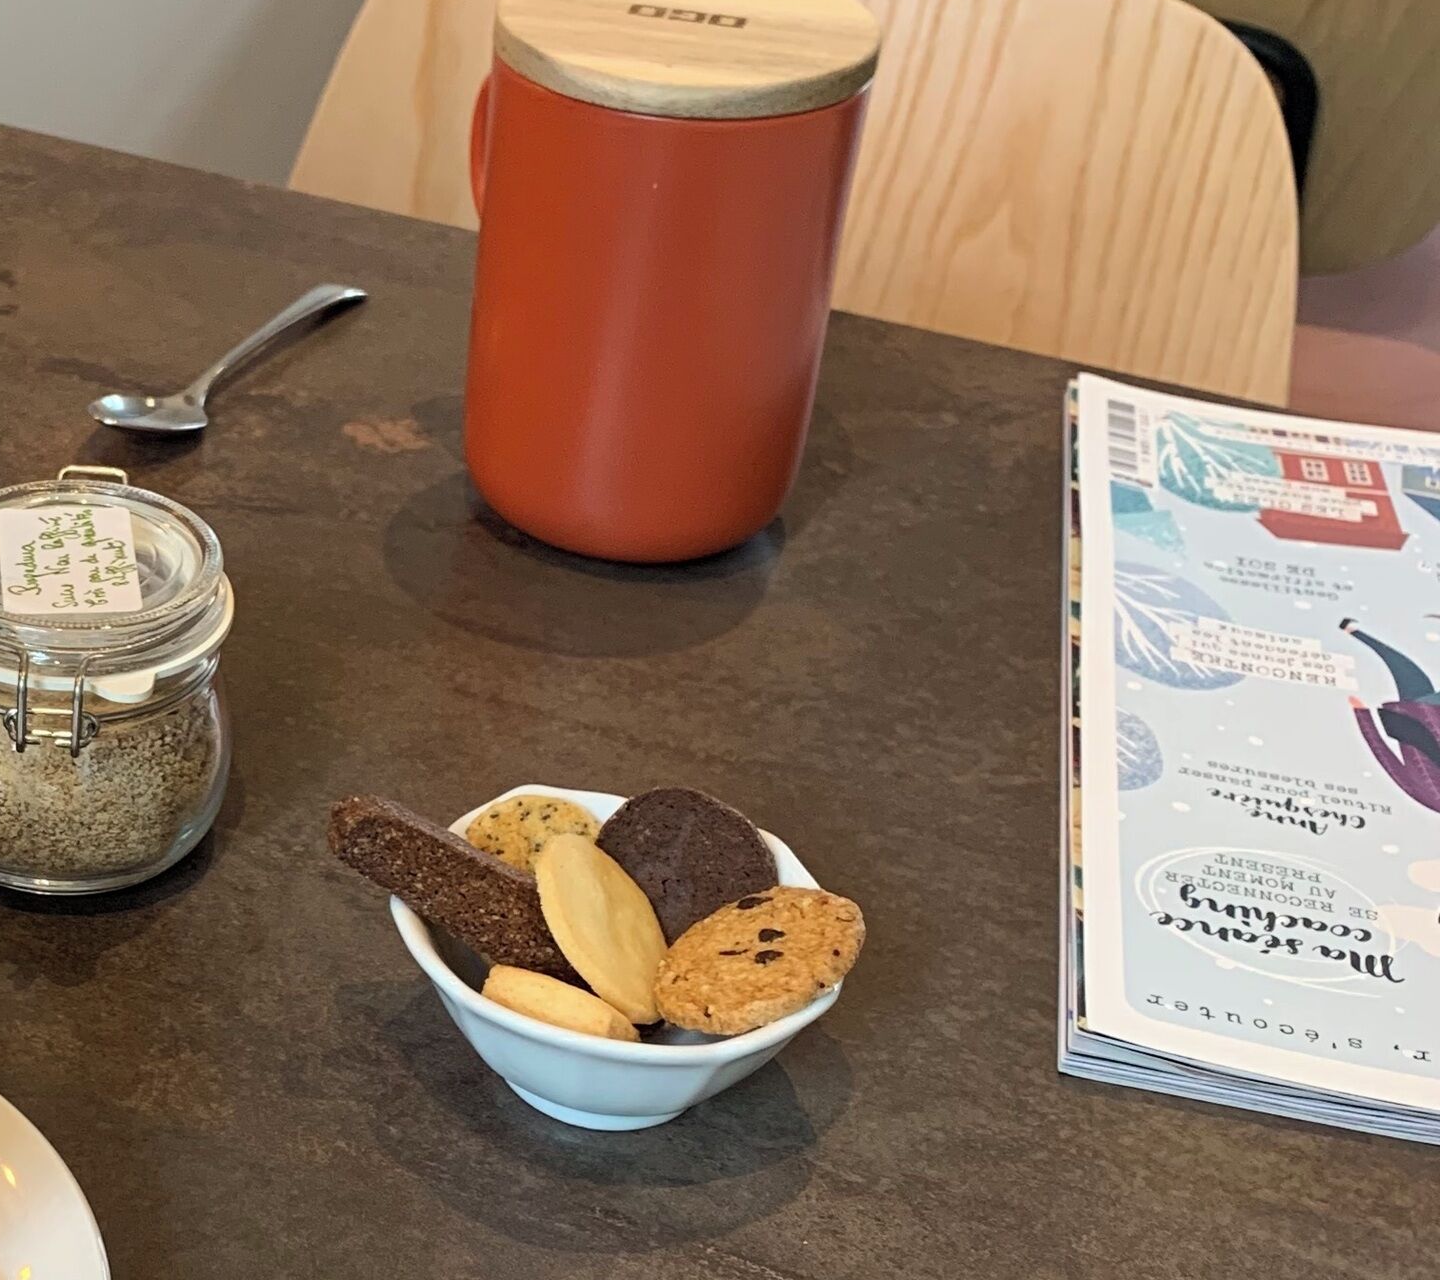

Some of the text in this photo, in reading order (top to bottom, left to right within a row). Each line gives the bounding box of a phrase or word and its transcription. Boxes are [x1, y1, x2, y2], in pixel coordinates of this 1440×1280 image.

[1192, 650, 1336, 686] RENCONTRE
[1178, 766, 1391, 816] Rituel pour panser
[1207, 760, 1358, 795] ses blessures
[1245, 809, 1328, 835] Anne
[1201, 864, 1336, 899] AU MOMENT
[1213, 853, 1322, 884] PRÉSENT
[1164, 871, 1378, 921] SE RECONNECTER
[1179, 884, 1372, 942] coaching
[1149, 911, 1405, 983] Ma séance
[1146, 994, 1362, 1050] s'écouter
